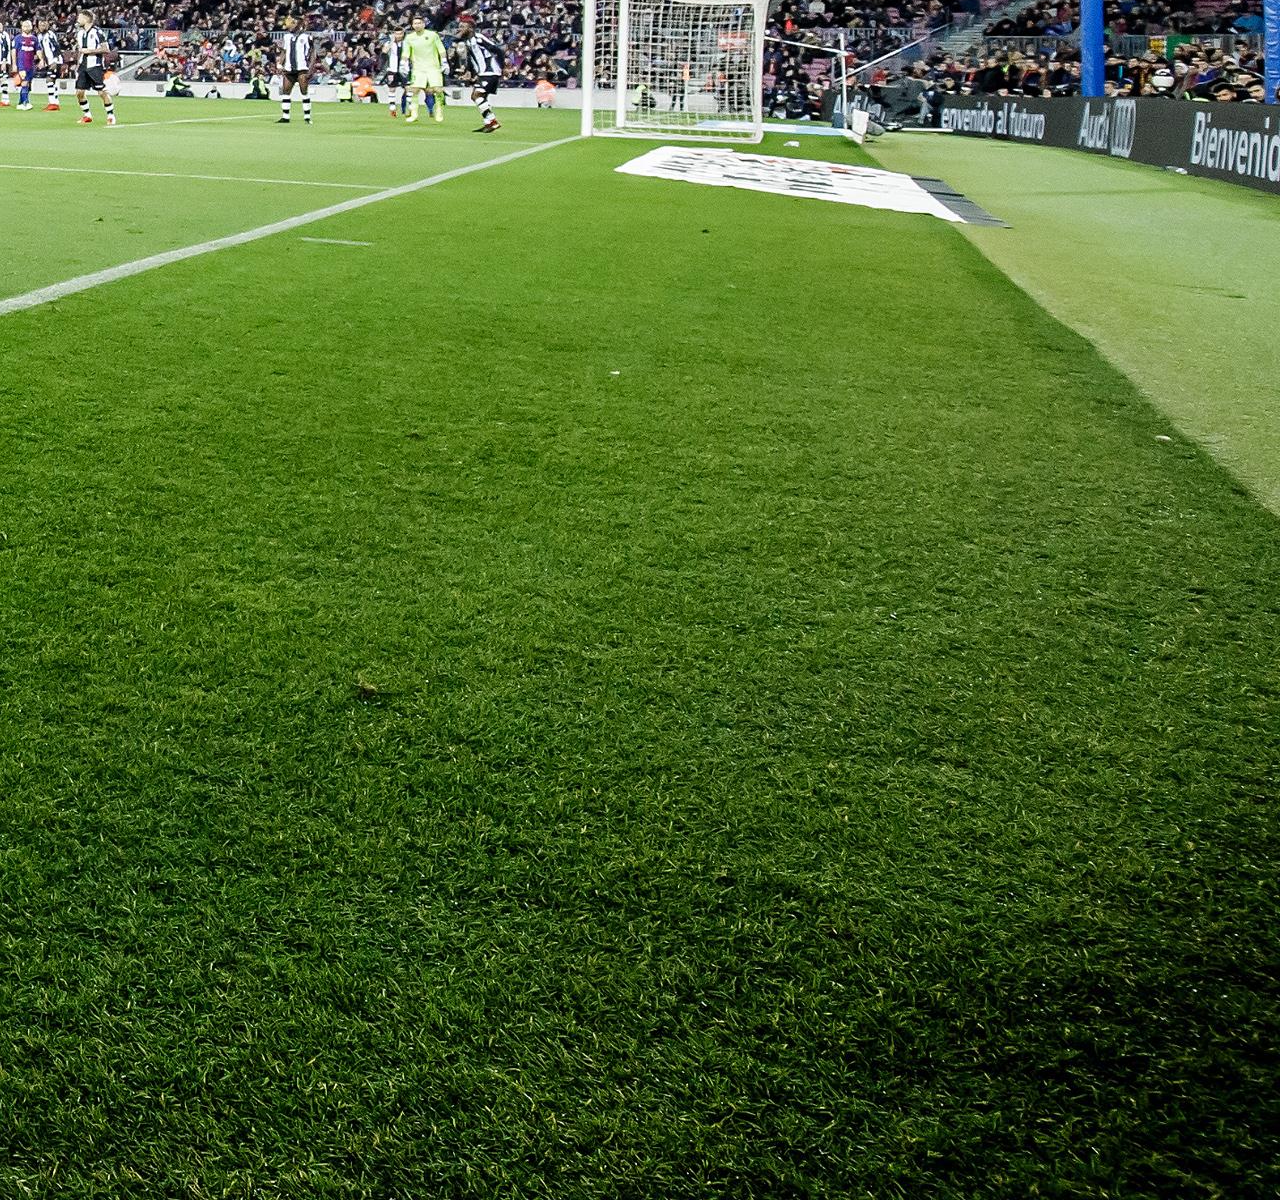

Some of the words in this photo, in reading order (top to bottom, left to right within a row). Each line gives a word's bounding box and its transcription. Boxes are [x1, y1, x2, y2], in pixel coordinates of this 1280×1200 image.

[942, 101, 994, 133] envenido
[996, 102, 1008, 135] al
[1009, 102, 1045, 139] futuro
[1078, 101, 1111, 150] Audi
